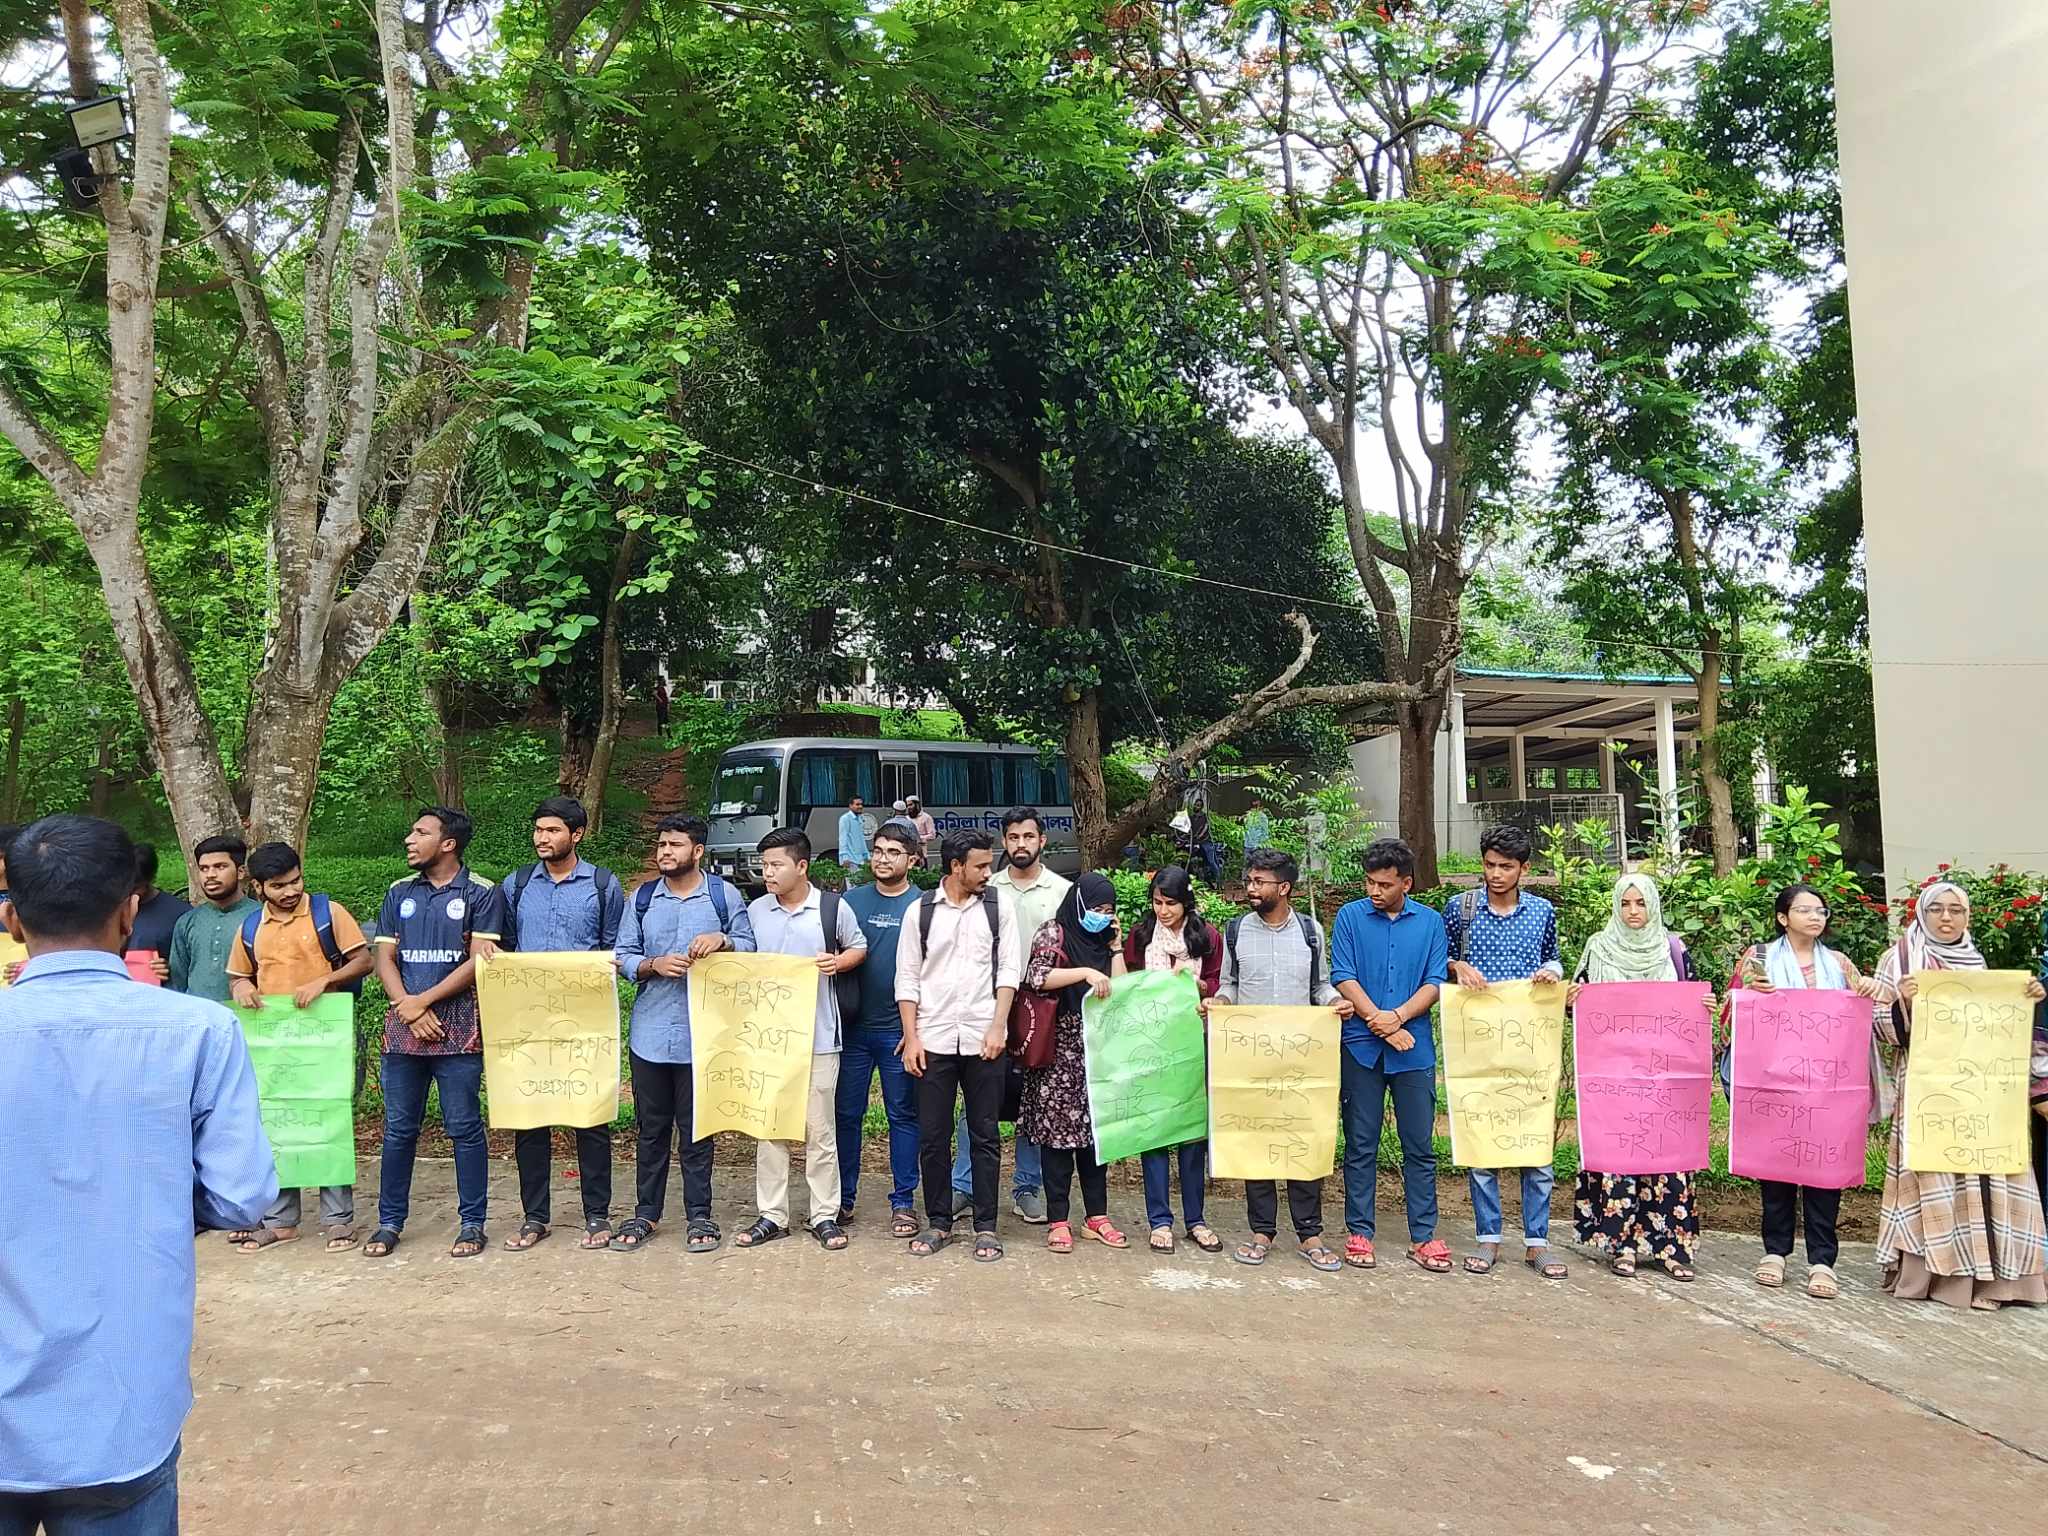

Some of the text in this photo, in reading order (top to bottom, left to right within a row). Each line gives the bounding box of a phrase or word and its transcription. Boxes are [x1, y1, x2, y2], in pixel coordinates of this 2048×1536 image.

[401, 949, 462, 963] HARMACY
[703, 961, 796, 1014] শিক্ষক
[1460, 993, 1559, 1055] শিক্ষক
[1587, 1008, 1713, 1044] অনলাইনে
[1743, 993, 1856, 1043] শিক্ষক
[1920, 981, 2029, 1041] শিক্ষক
[1219, 1014, 1324, 1060] শিক্ষক
[1251, 1064, 1327, 1104] চাই
[1740, 1089, 1830, 1132] বিভাগ
